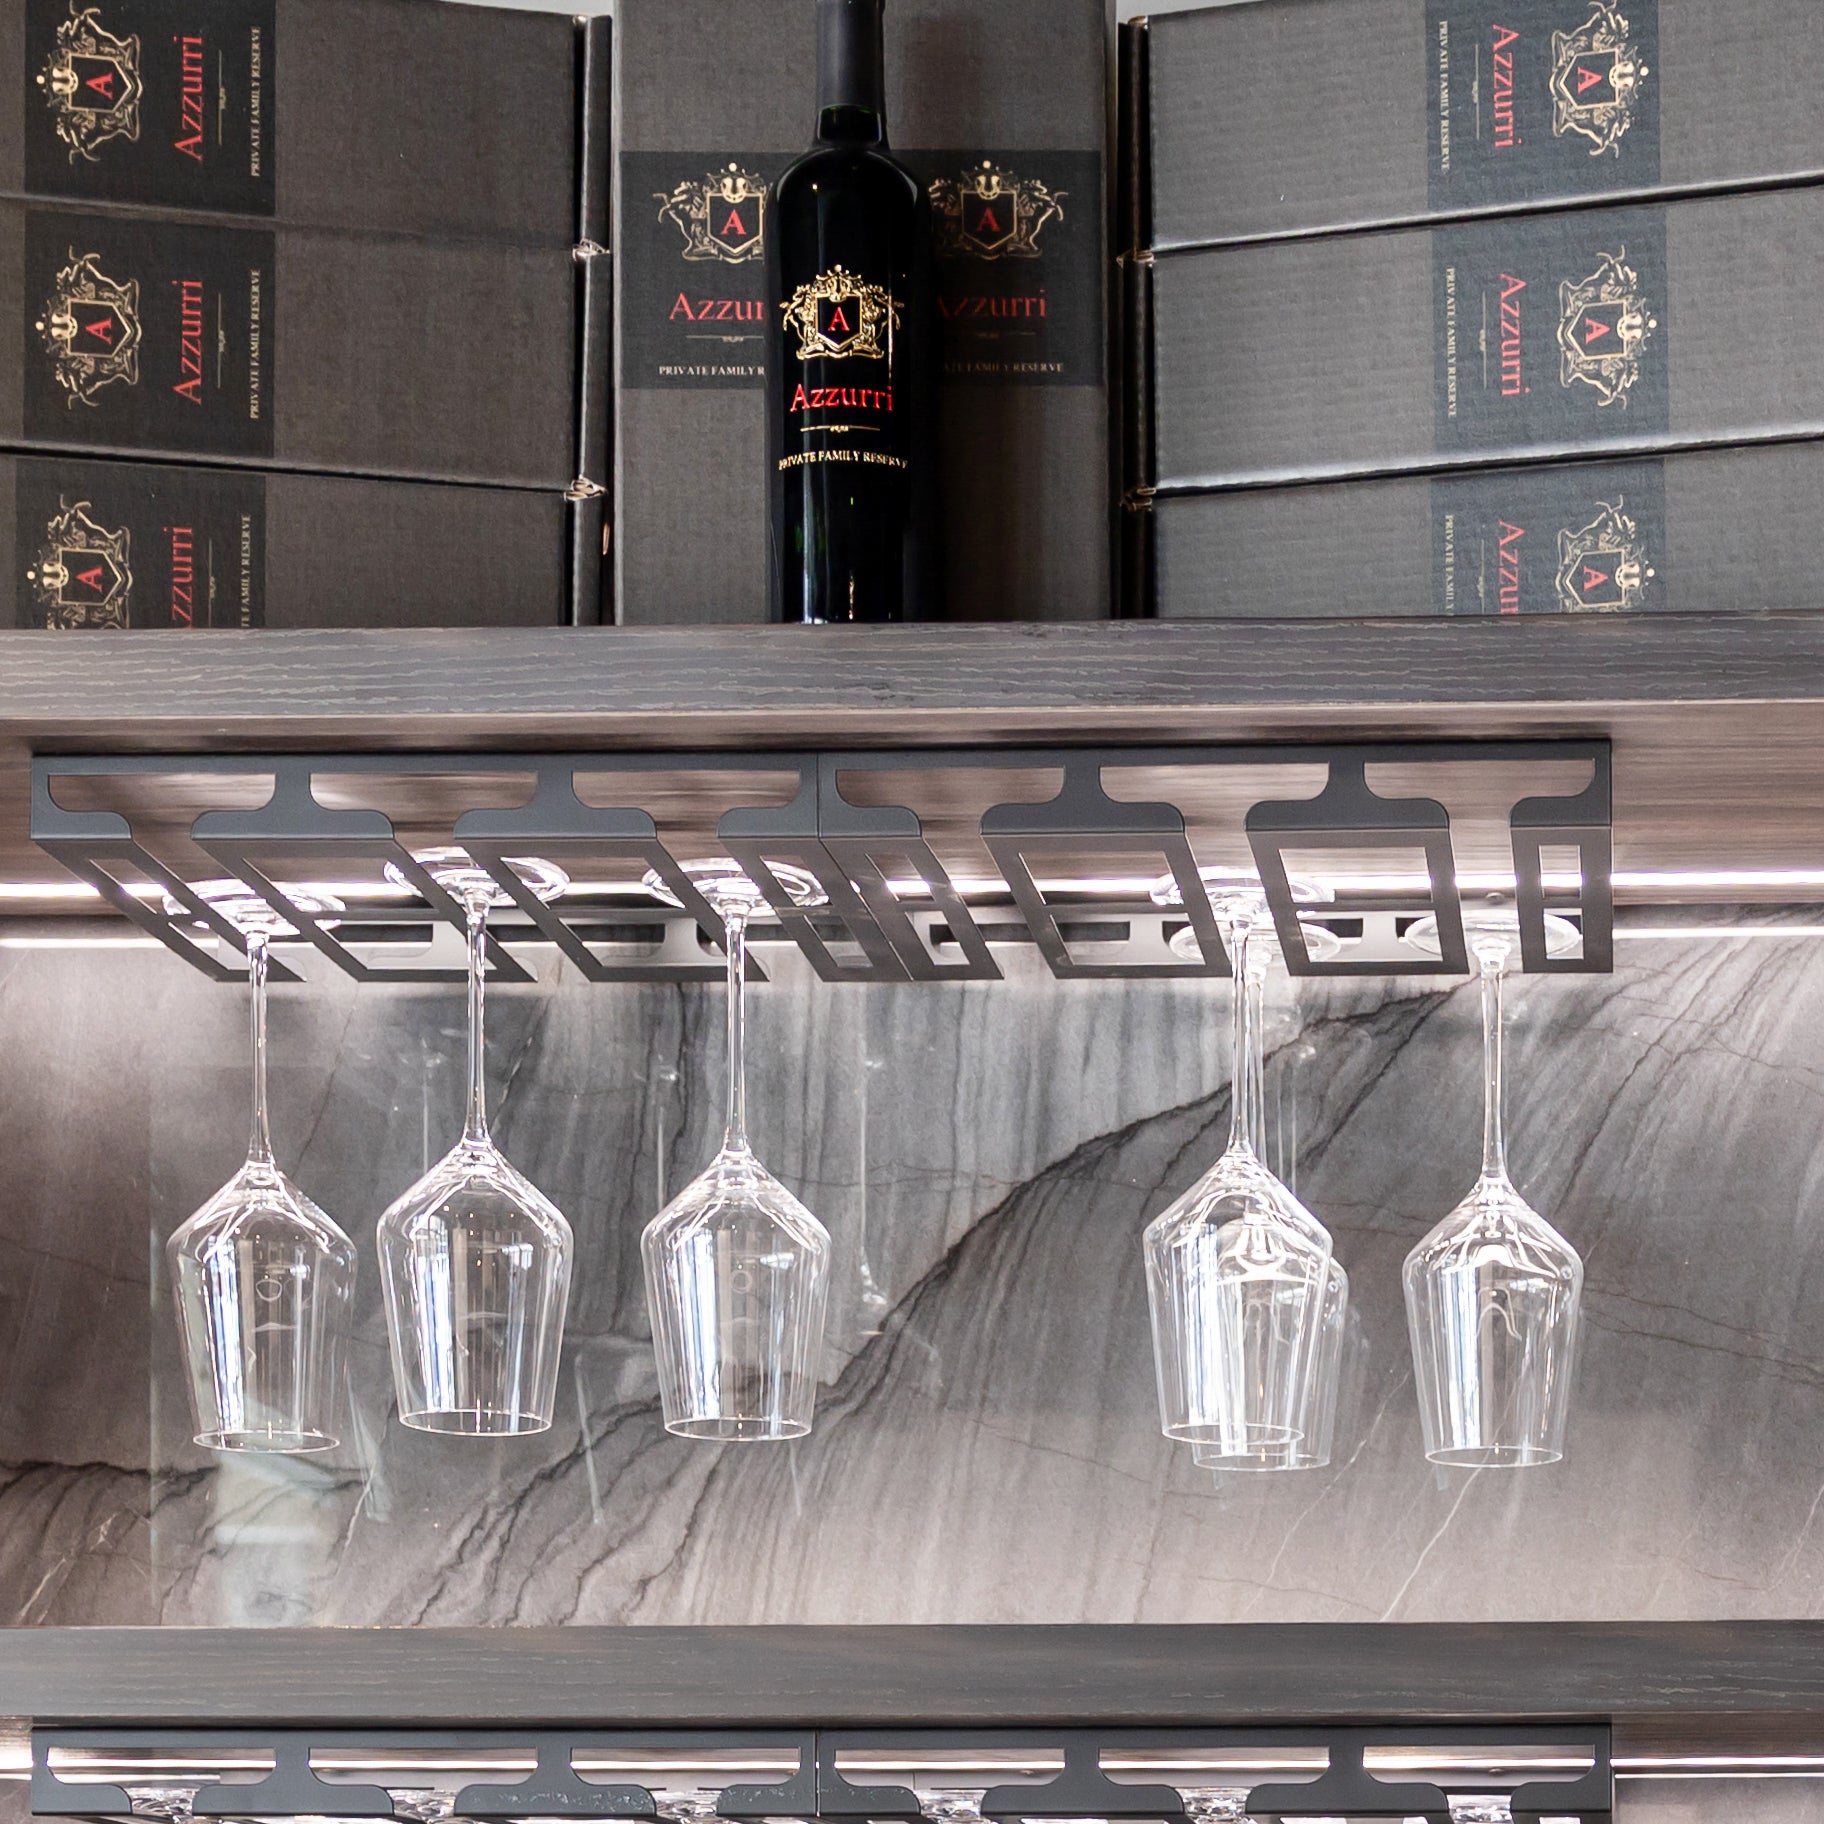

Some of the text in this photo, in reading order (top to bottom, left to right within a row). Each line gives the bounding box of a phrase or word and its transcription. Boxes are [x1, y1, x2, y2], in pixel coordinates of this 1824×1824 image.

[85, 73, 113, 100] A
[1492, 23, 1523, 149] Azzurri
[1577, 66, 1603, 94] A
[173, 35, 204, 163] Azzurri
[250, 26, 261, 178] PRIVATE FAMILY RESERVE
[1439, 20, 1451, 171] PRIVATE FAMILY RESERVE
[720, 209, 747, 236] A
[977, 207, 1001, 232] A
[85, 317, 113, 345] A
[828, 306, 851, 332] A
[1584, 317, 1611, 345] A
[171, 279, 204, 406] Azzurri
[249, 269, 262, 420] PRIVATE FAMILY RESERVE
[1446, 267, 1458, 419] PRIVATE FAMILY RESERVE
[1499, 273, 1532, 397] Azzurri
[659, 365, 709, 376] PRIVATE
[711, 365, 755, 376] FAMILY
[1012, 362, 1064, 373] RESERVE
[789, 383, 894, 413] Azzurri
[778, 450, 909, 471] PRIVATE FAMILY RESERVE
[240, 513, 253, 567] RESERVE
[162, 526, 194, 629] zzurri
[1445, 514, 1455, 611] PRIVATE FAMILY
[75, 566, 104, 594] A
[240, 568, 252, 613] FAMILY
[1583, 565, 1609, 592] A
